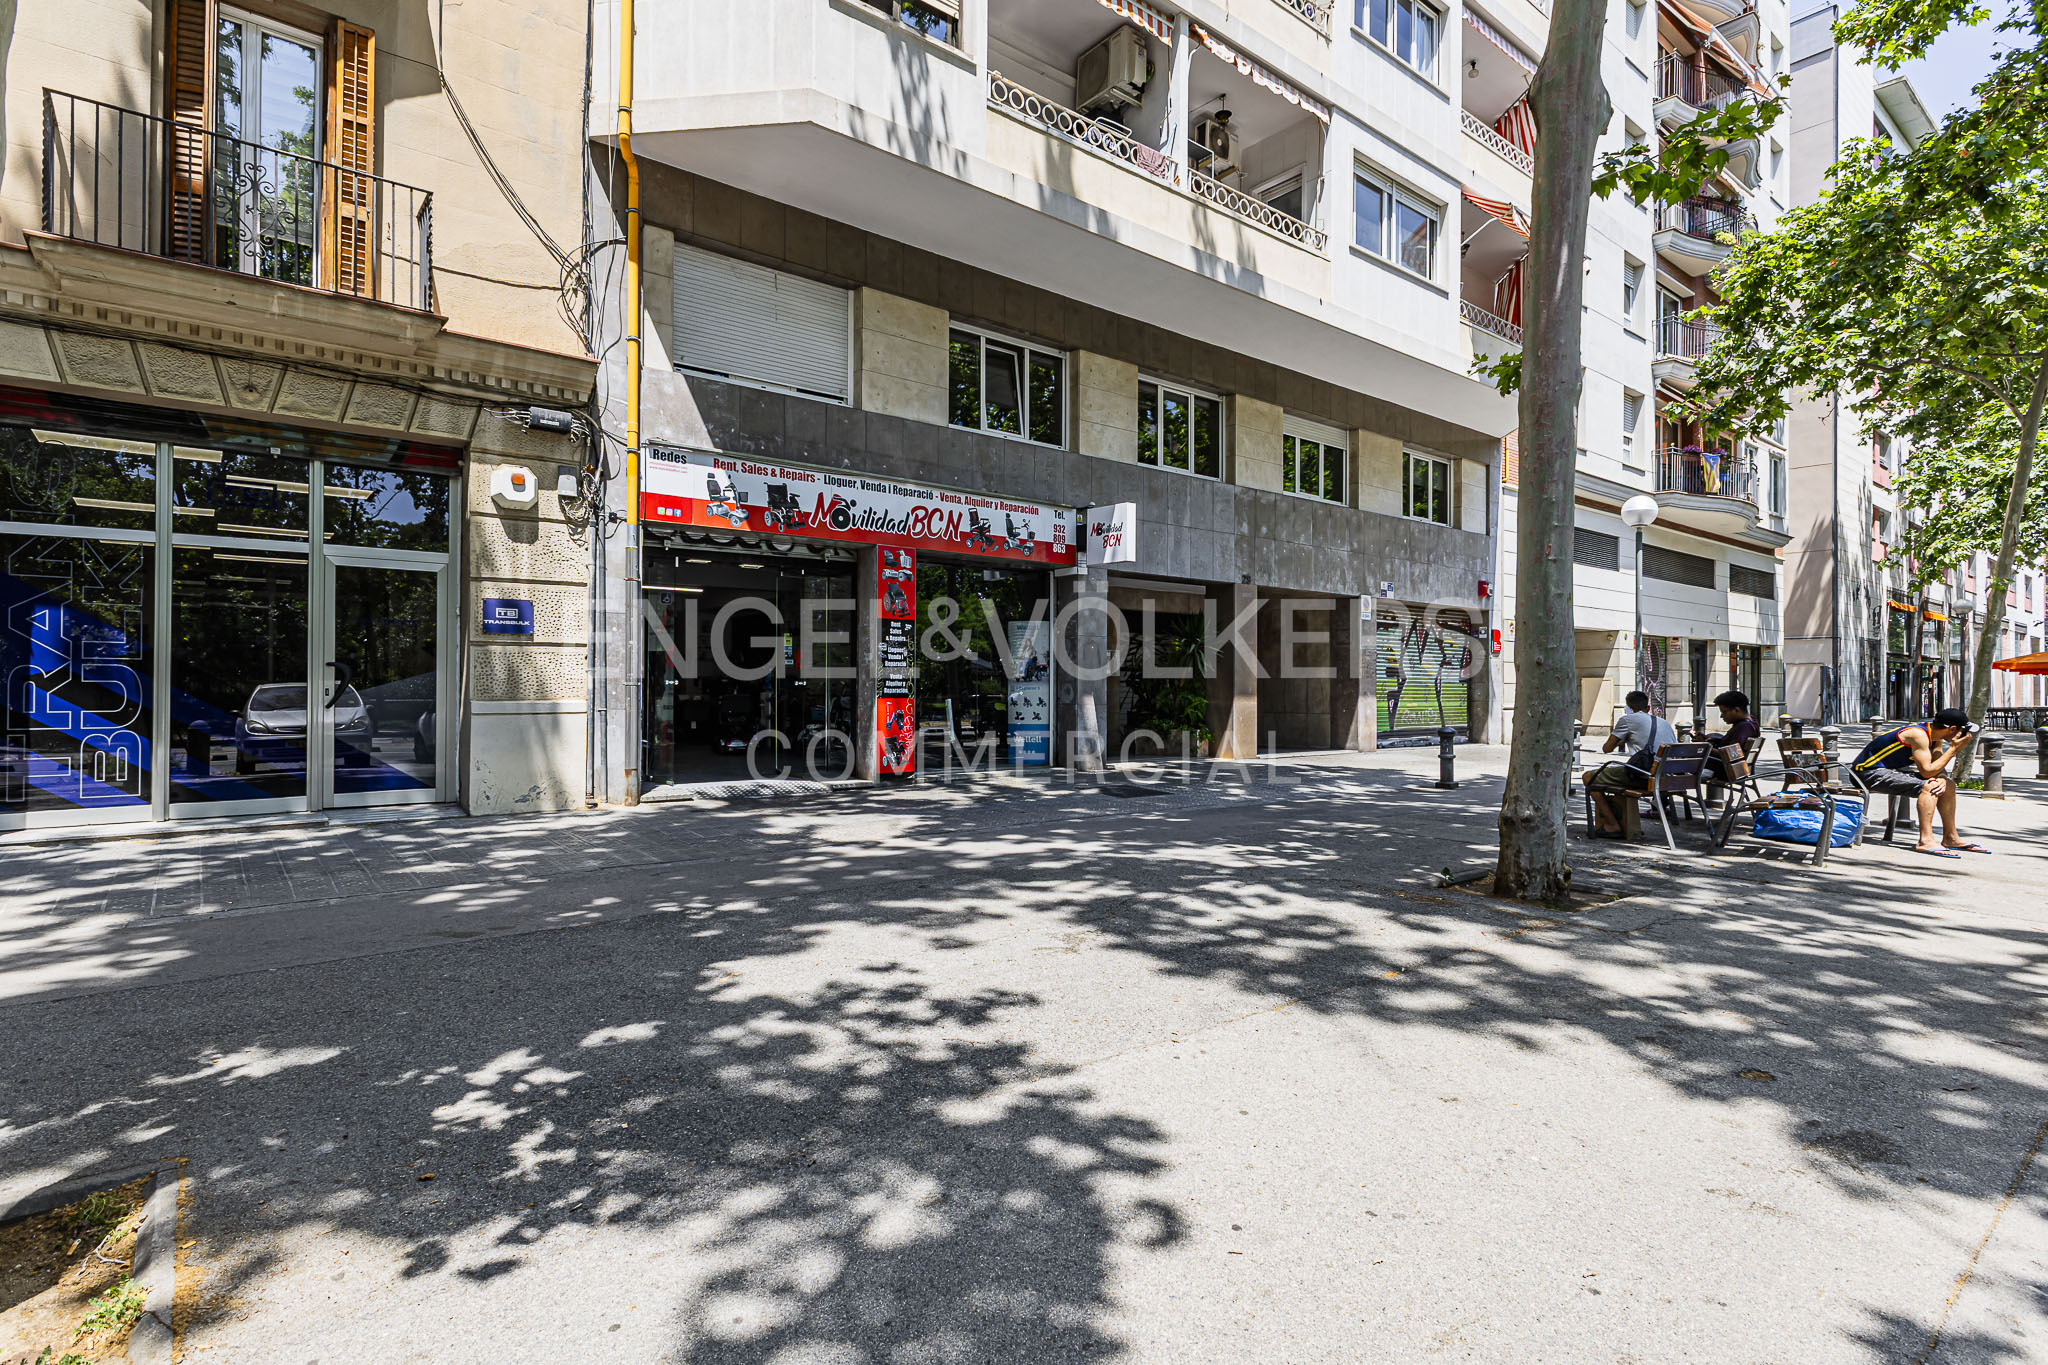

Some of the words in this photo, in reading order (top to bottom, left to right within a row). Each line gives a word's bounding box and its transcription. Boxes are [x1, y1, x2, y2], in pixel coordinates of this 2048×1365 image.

[653, 449, 687, 464] Redes
[713, 458, 739, 473] Rent,
[741, 462, 769, 477] Sales
[770, 469, 778, 478] &
[779, 468, 816, 483] Repairs
[823, 474, 859, 490] Lloguer,
[860, 480, 887, 493] Venda
[893, 485, 934, 500] Reparació
[939, 492, 964, 506] Venta,
[964, 496, 993, 509] Alquiler
[994, 500, 999, 510] y
[1000, 502, 1039, 516] Reparación
[1053, 510, 1066, 520] Tel.
[1053, 524, 1066, 534] 932
[1053, 534, 1066, 544] 809
[1102, 533, 1123, 549] BCN
[1053, 543, 1066, 554] 863
[79, 537, 144, 799] BULK
